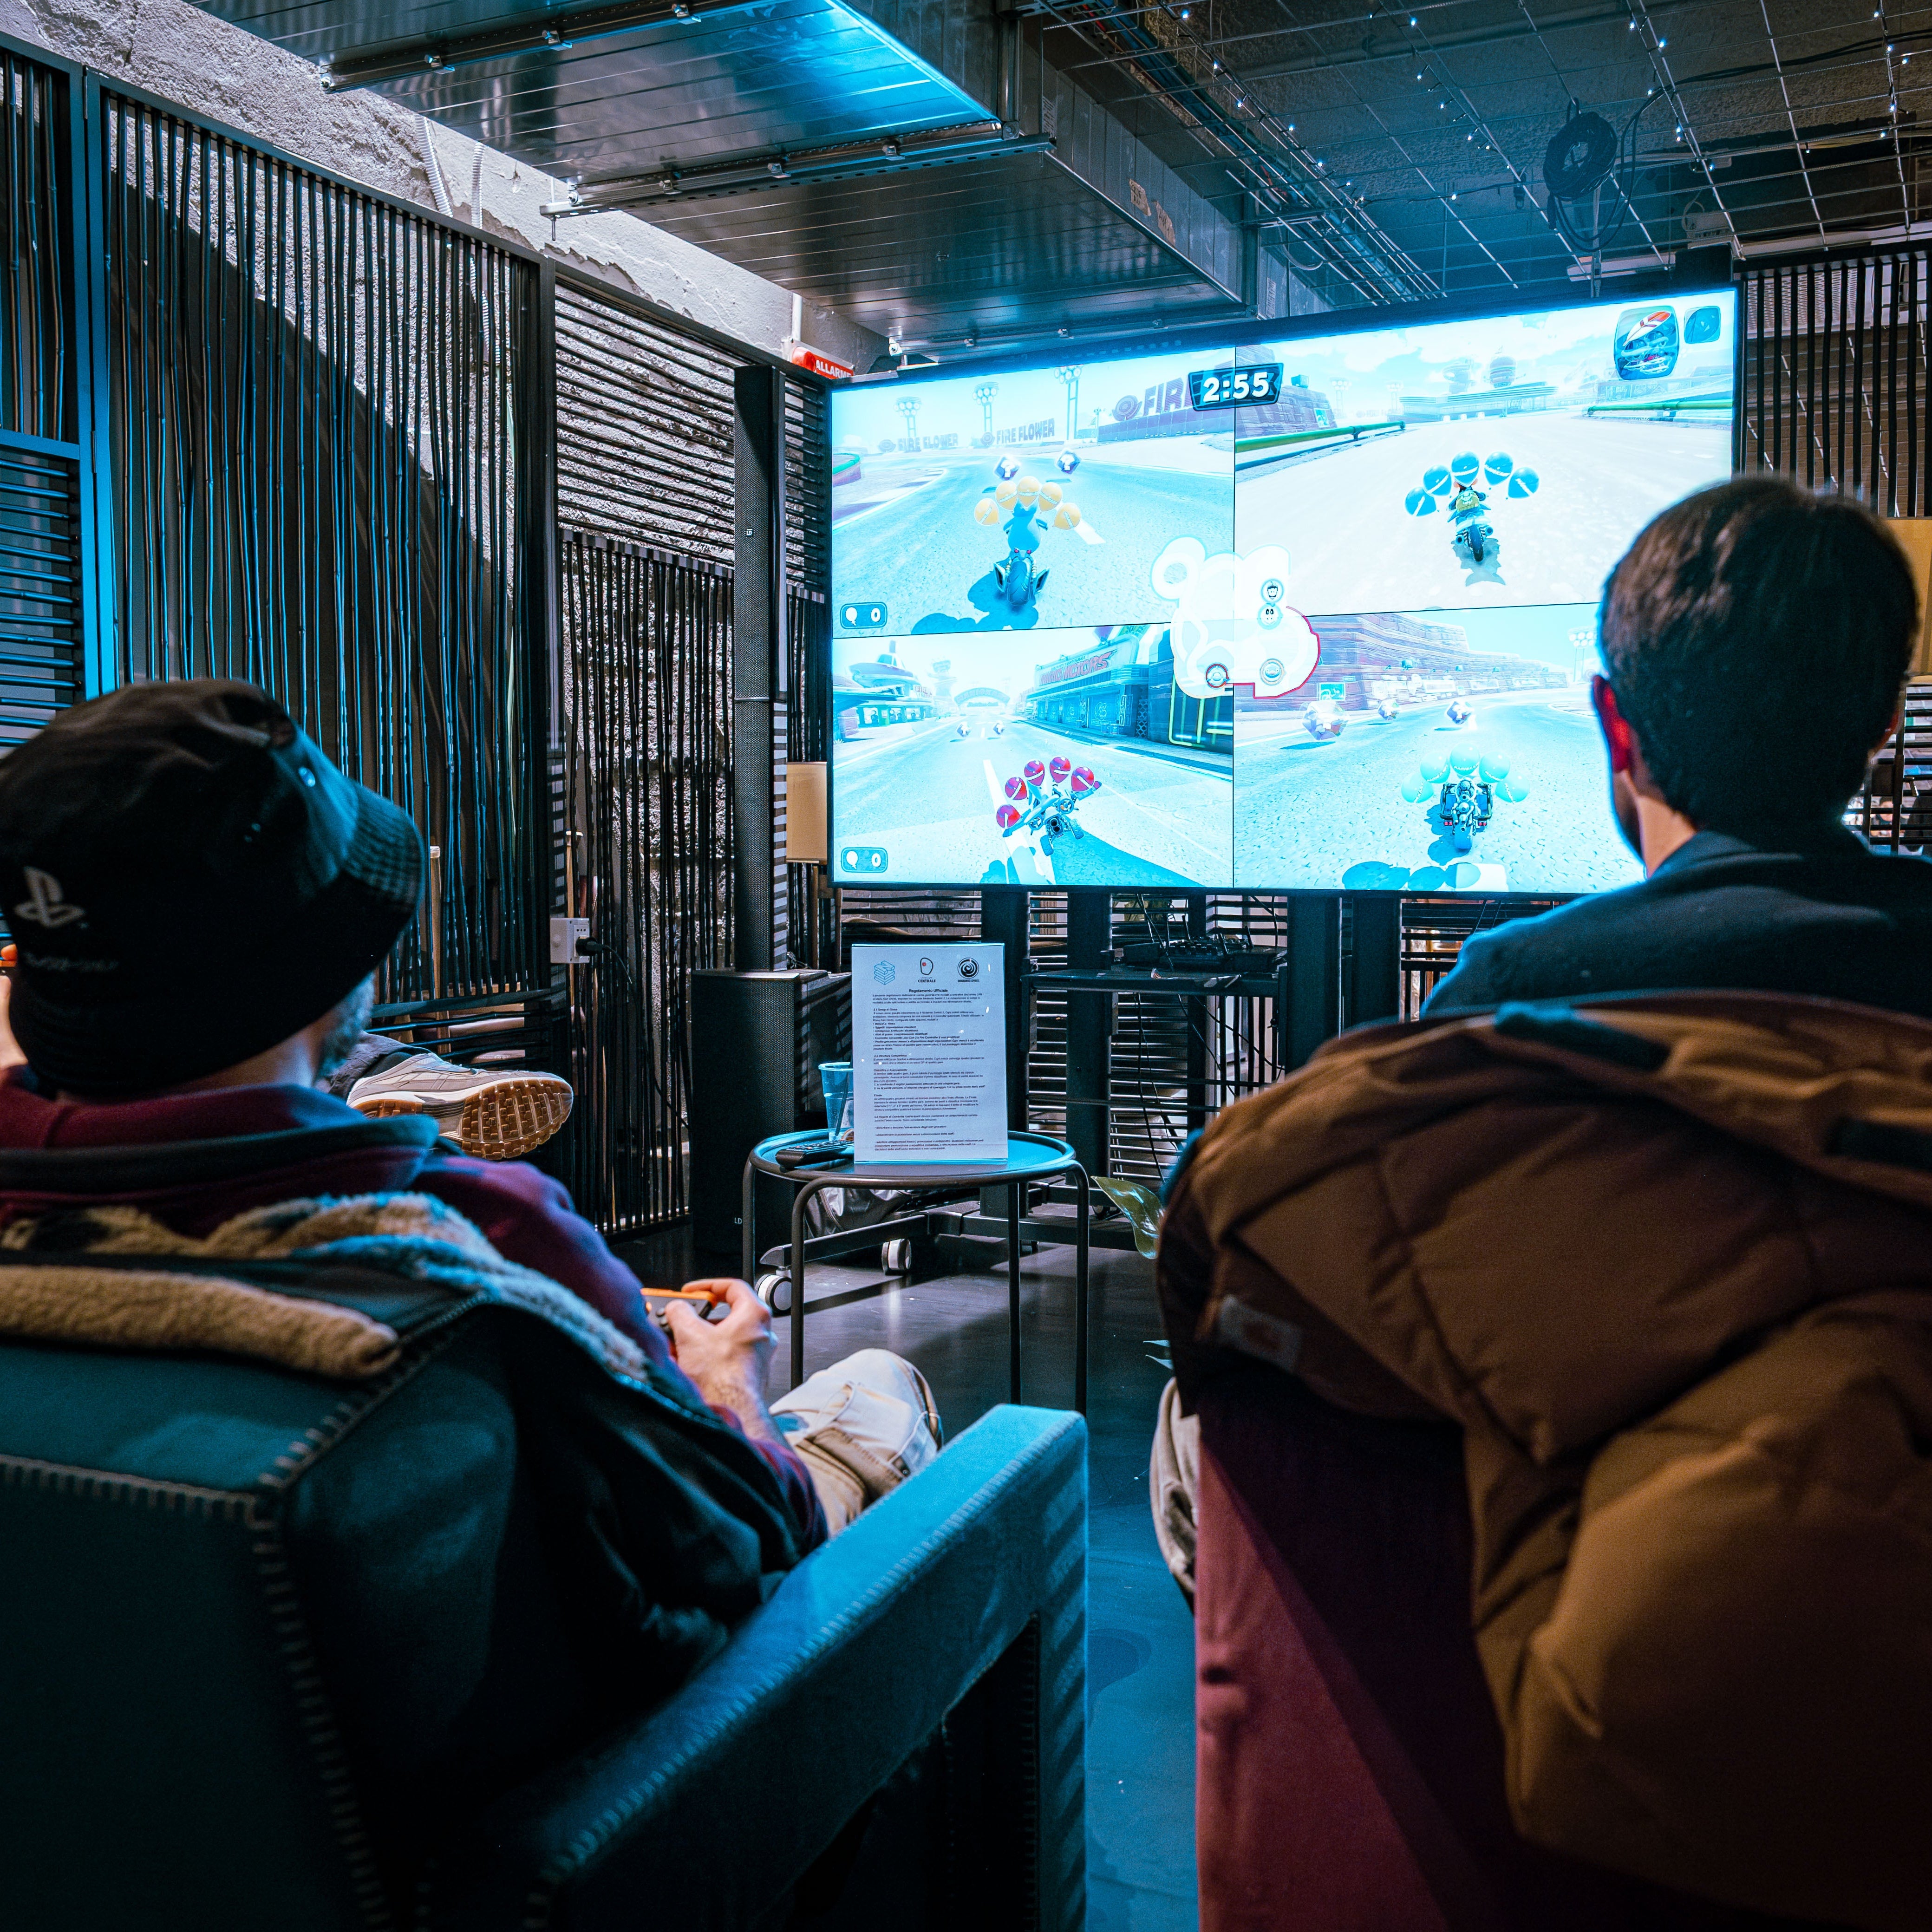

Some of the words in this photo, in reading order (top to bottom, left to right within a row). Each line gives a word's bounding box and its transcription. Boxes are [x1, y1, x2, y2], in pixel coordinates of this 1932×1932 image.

[1203, 372, 1269, 402] 2:55
[996, 428, 1016, 444] FIRE
[1018, 418, 1055, 441] FLOWER
[898, 437, 921, 452] FIRE
[923, 433, 959, 449] FLOWER
[871, 607, 881, 622] 0
[1063, 649, 1116, 680] MOTORS
[871, 853, 881, 867] 0
